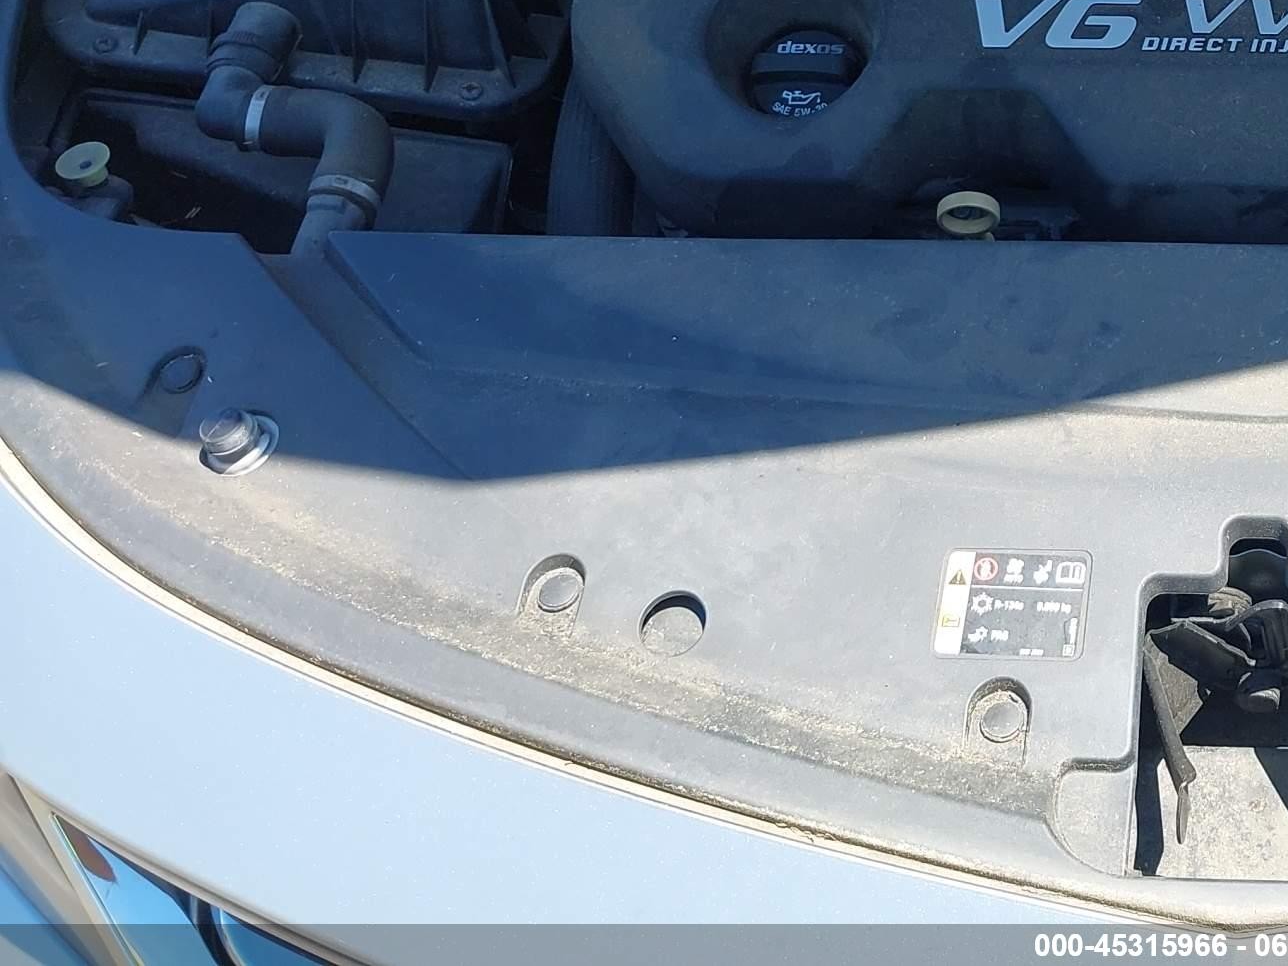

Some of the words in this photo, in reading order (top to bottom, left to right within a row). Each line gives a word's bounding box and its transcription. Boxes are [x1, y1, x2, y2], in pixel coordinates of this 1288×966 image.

[776, 40, 846, 54] dexos
[1141, 36, 1243, 52] DIRECT
[772, 101, 792, 115] SAE
